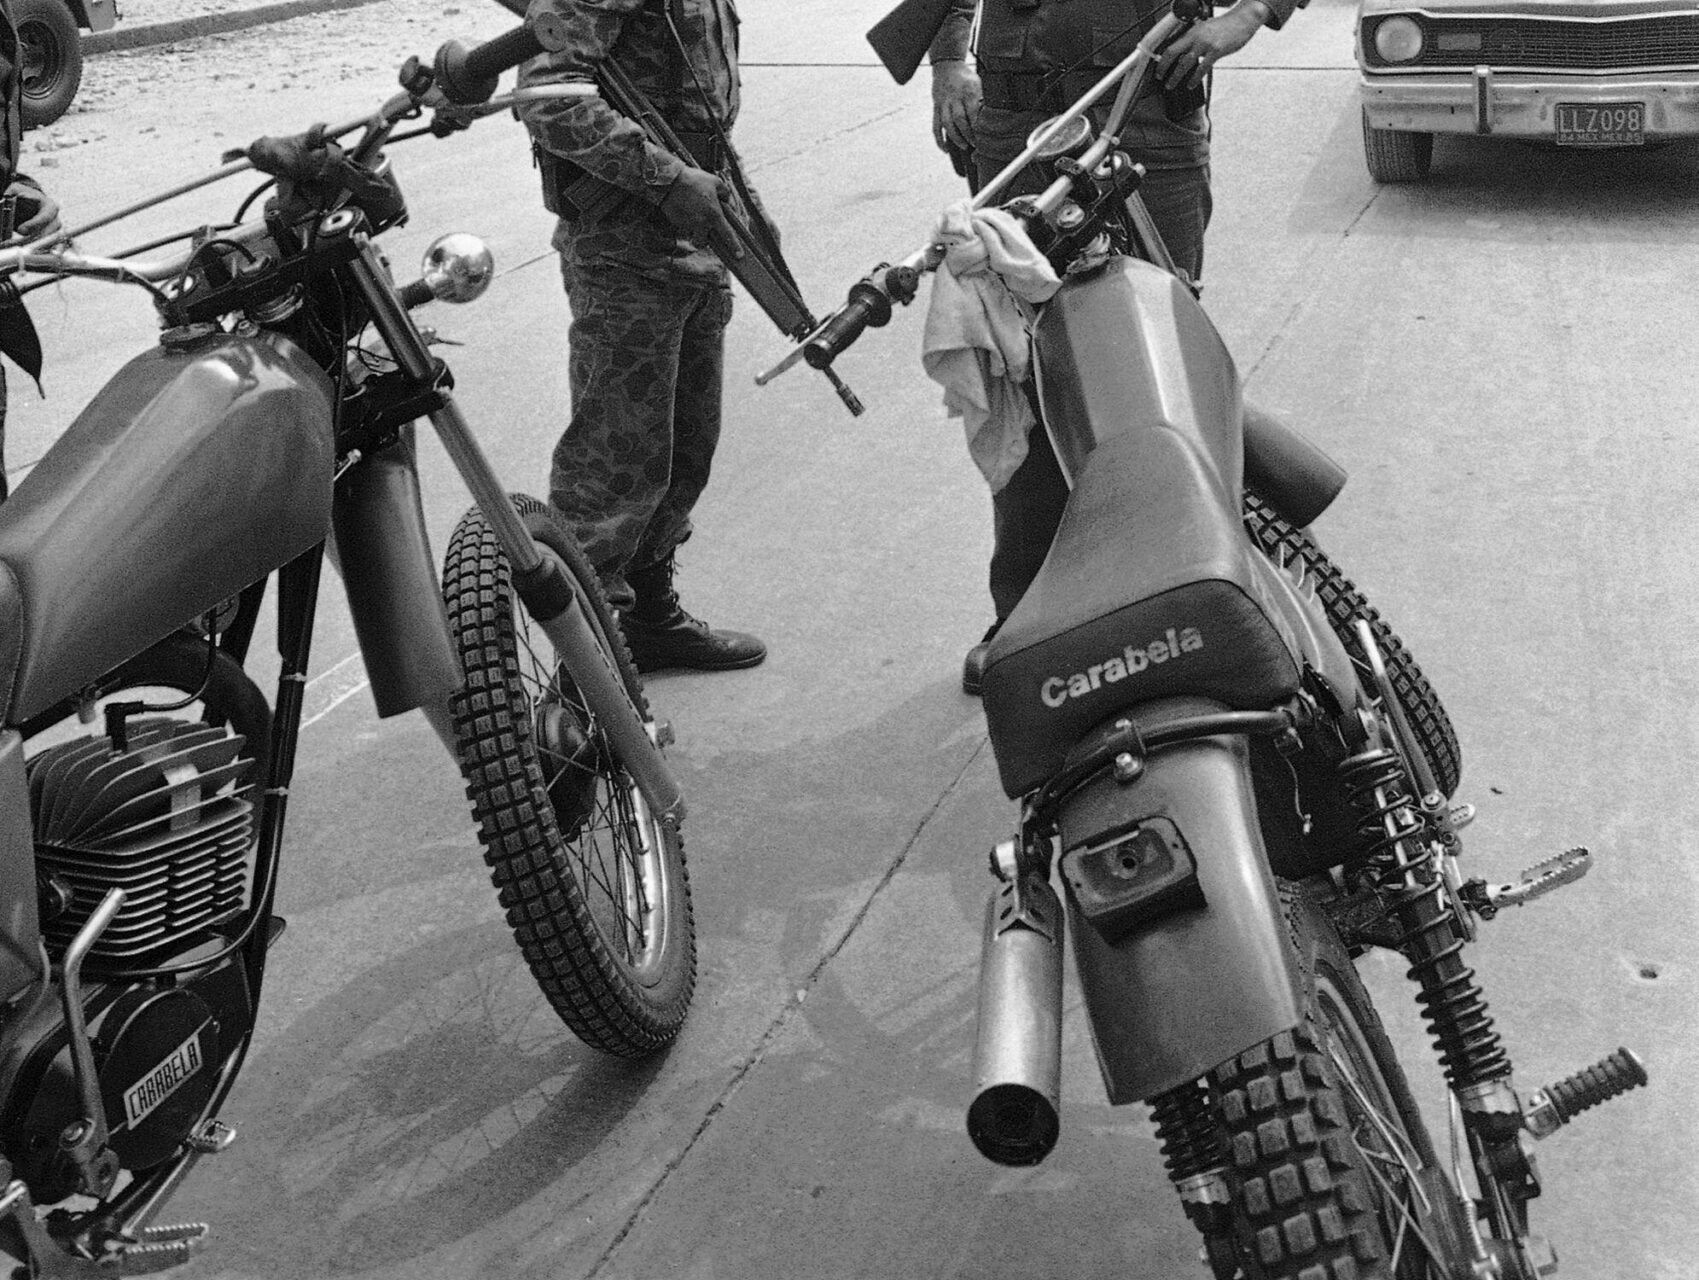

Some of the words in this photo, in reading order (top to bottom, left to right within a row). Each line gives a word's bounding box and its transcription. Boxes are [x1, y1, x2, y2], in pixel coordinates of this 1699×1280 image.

[1559, 108, 1640, 133] LLZ098
[1040, 626, 1204, 708] Carabela
[127, 1040, 200, 1122] CARABELA
